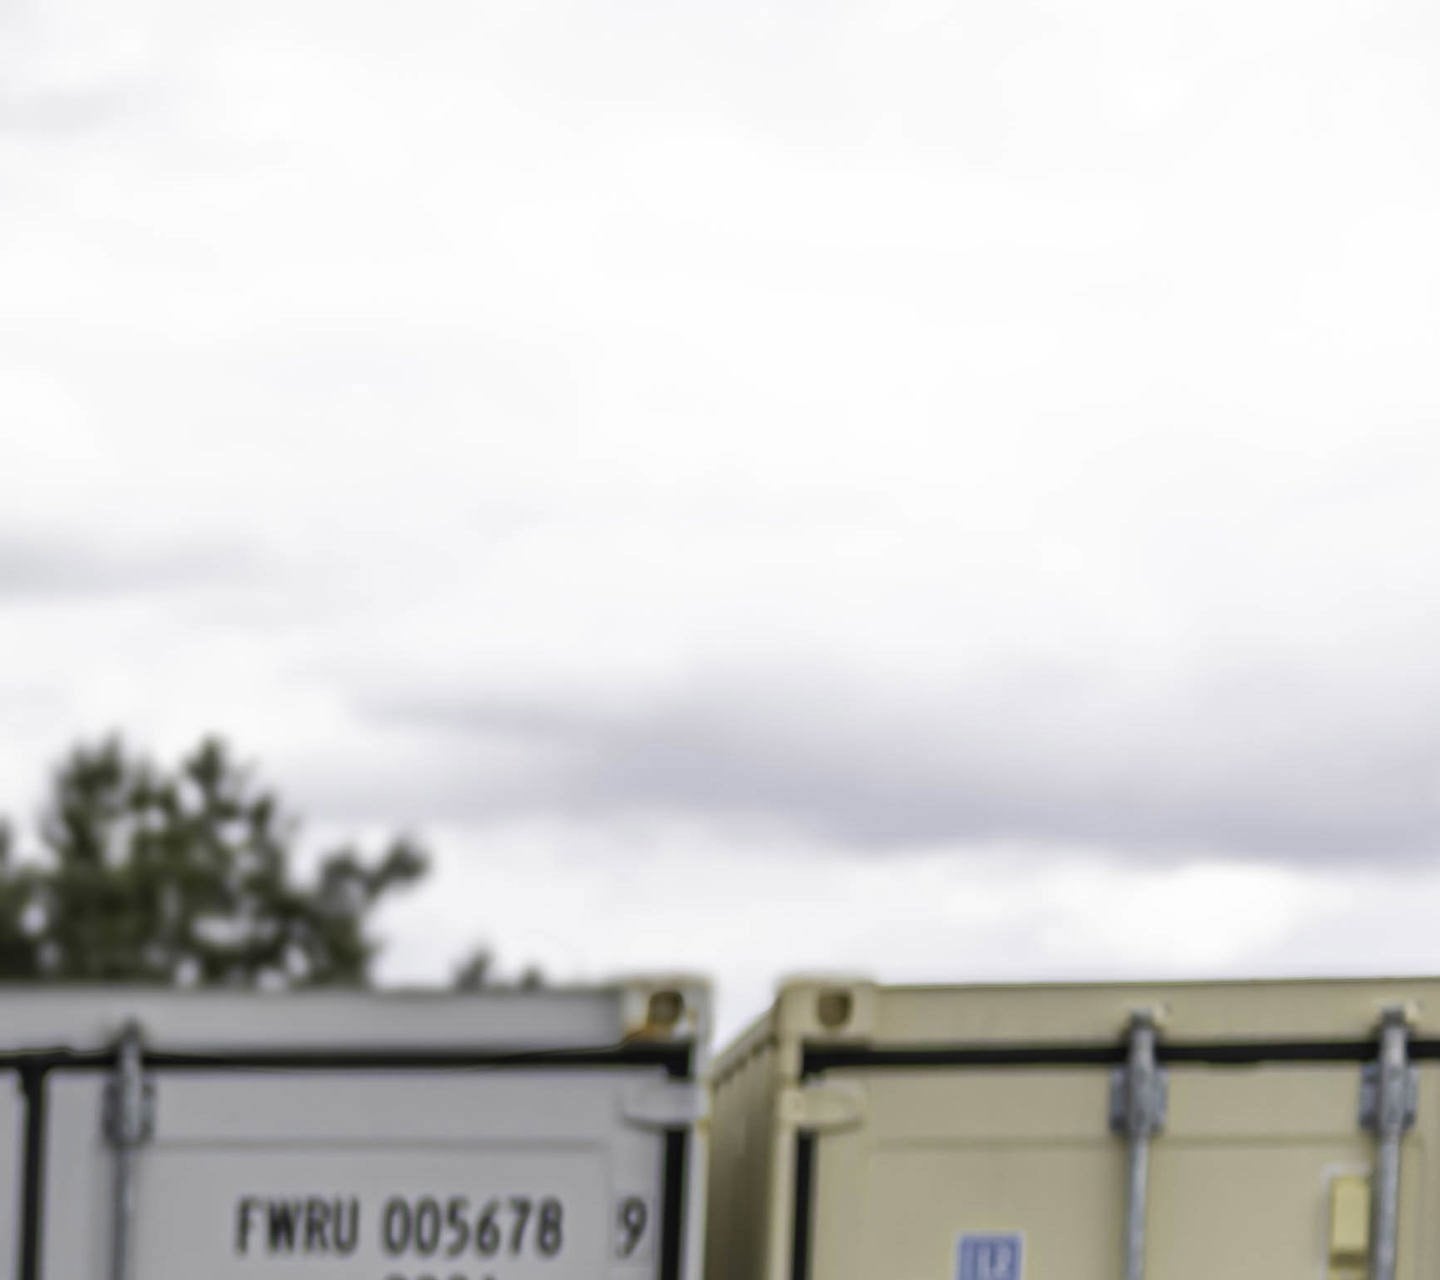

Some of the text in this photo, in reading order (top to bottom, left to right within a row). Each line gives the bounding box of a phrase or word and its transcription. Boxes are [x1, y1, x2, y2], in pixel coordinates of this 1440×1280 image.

[235, 1196, 649, 1260] FWRU 005678 9
